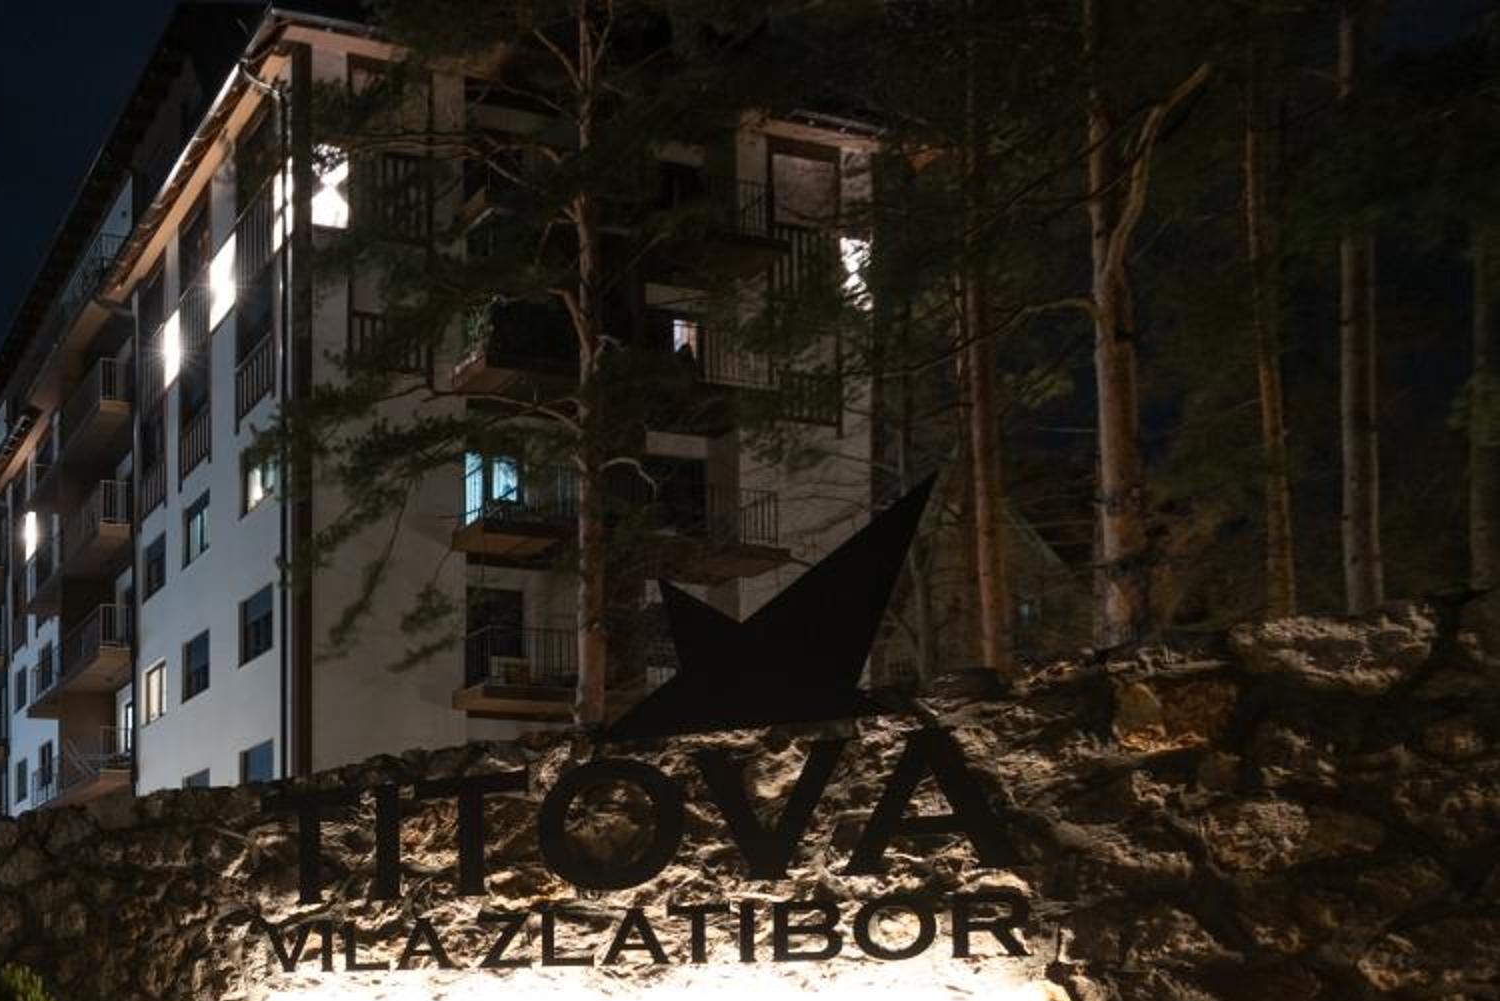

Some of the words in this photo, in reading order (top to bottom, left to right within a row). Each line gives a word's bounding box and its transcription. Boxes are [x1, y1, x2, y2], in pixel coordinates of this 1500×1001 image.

[260, 722, 1020, 900] TITOVA
[256, 914, 454, 972] VILA
[478, 888, 1031, 965] ZLATIBOR
